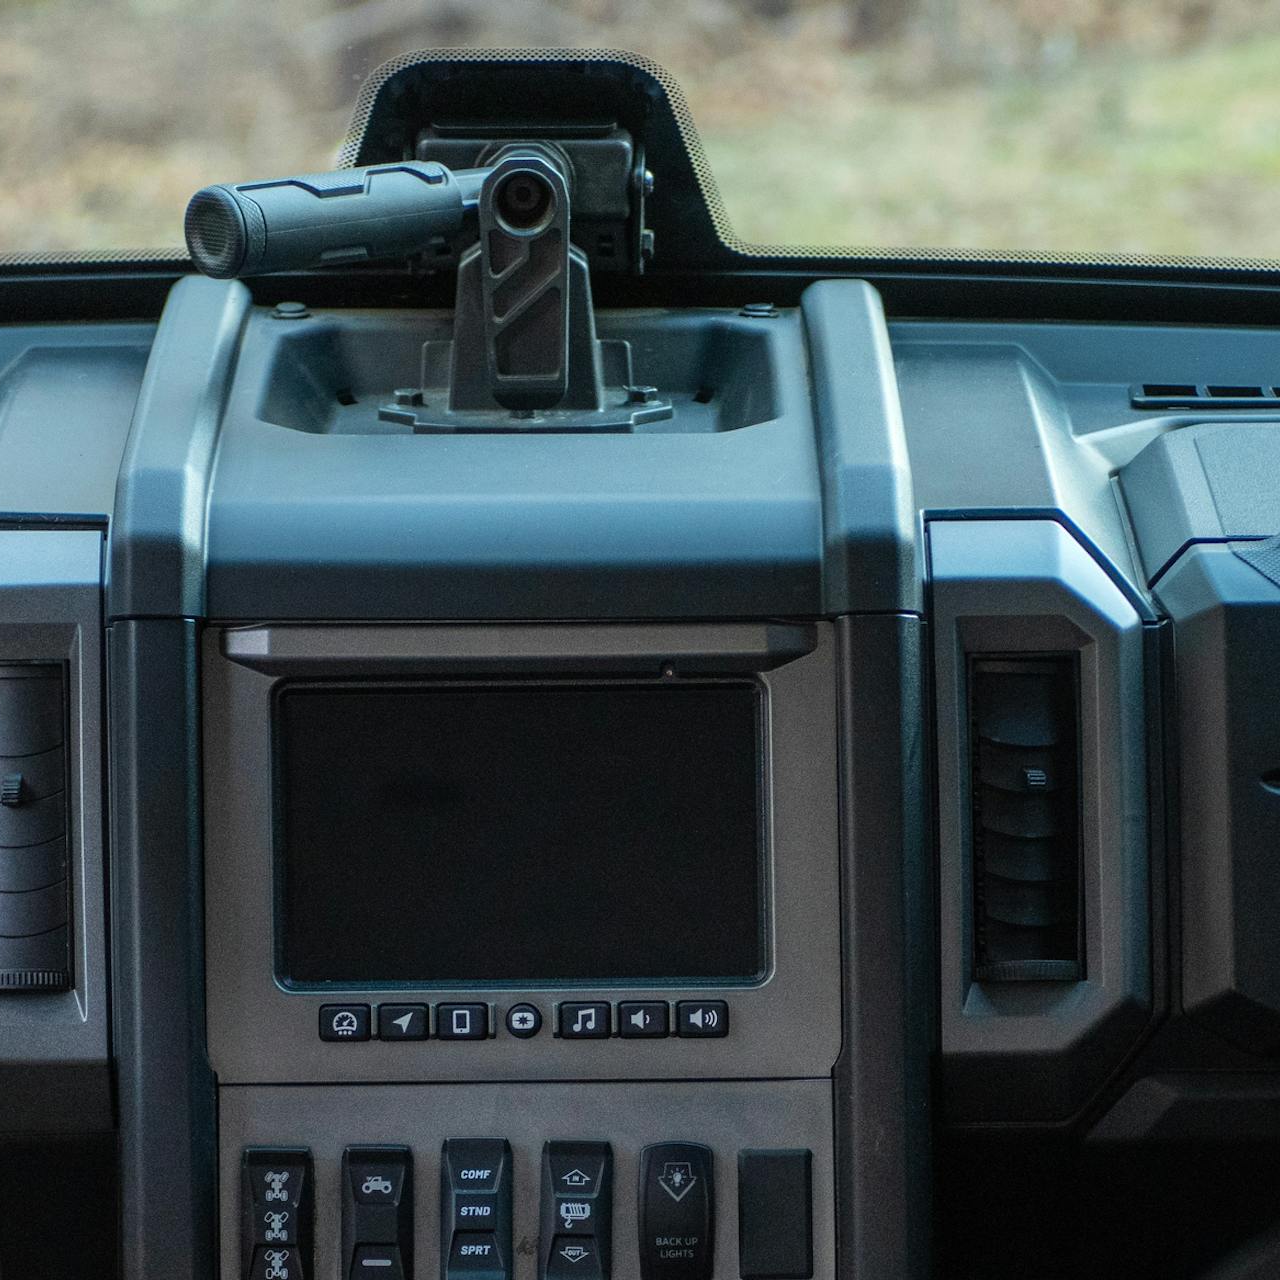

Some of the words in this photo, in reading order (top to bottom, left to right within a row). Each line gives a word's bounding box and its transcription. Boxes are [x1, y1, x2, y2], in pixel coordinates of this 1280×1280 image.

[460, 1169, 492, 1180] COMF
[460, 1206, 491, 1216] STND
[655, 1236, 682, 1246] BACK
[684, 1236, 698, 1246] UP
[460, 1245, 491, 1256] SPRT
[568, 1249, 581, 1257] OUT
[660, 1249, 695, 1258] LIGHTS
